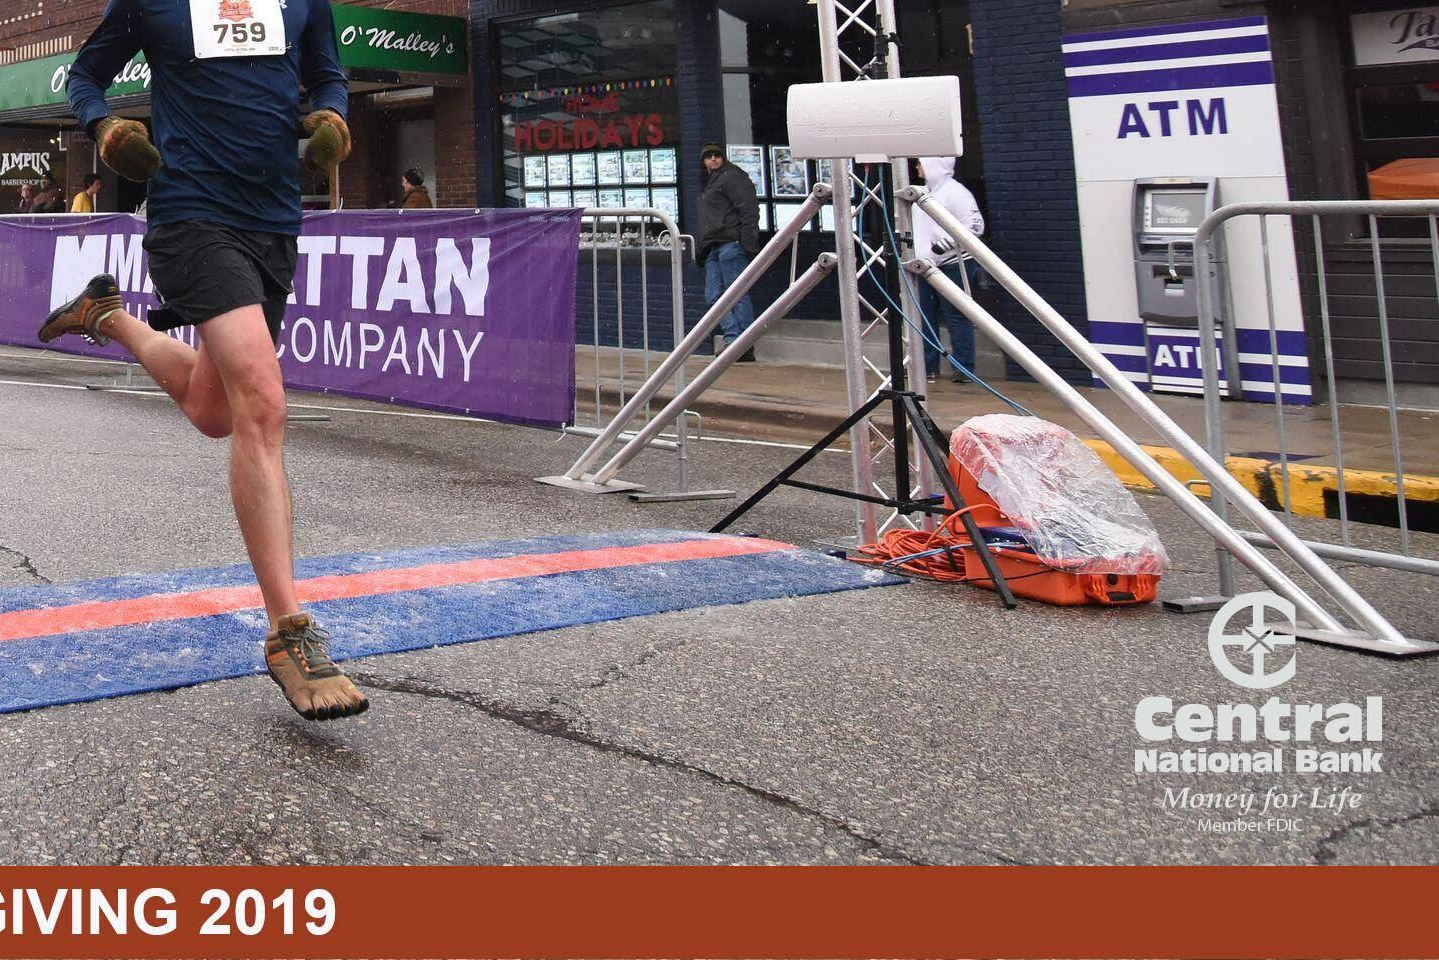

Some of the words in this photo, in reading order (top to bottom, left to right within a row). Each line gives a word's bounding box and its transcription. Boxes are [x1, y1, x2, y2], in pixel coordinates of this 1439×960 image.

[213, 22, 266, 44] 759
[340, 25, 454, 59] O'Malley's
[514, 113, 664, 151] HOLIDAYS
[1117, 97, 1228, 139] ATM
[1, 178, 42, 187] BARBERSHOP
